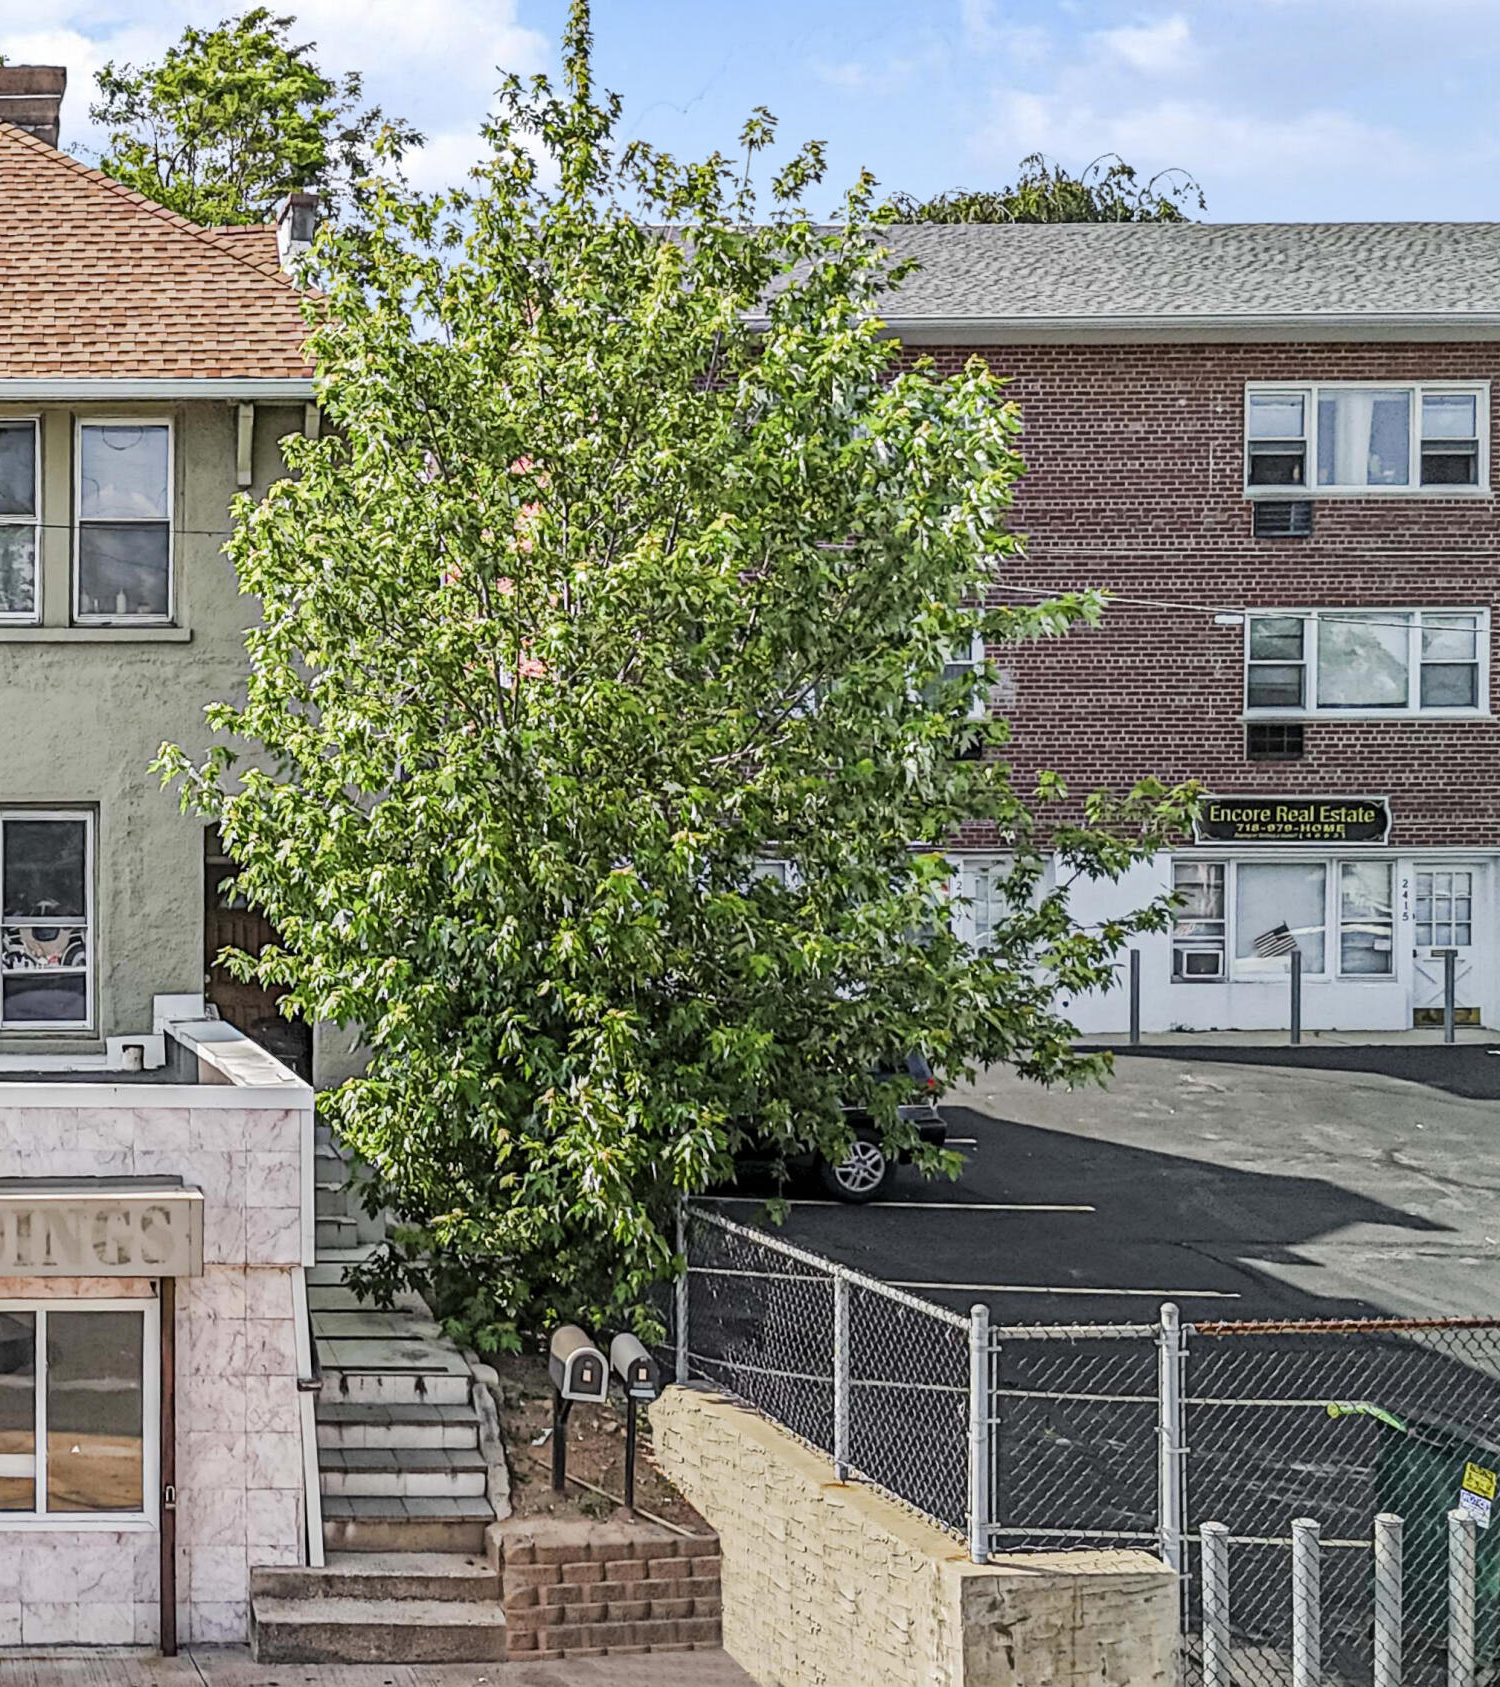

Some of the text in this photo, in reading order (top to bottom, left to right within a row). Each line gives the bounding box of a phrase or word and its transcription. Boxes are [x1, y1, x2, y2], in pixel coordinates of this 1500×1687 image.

[1209, 805, 1376, 822] Encore Real Estate
